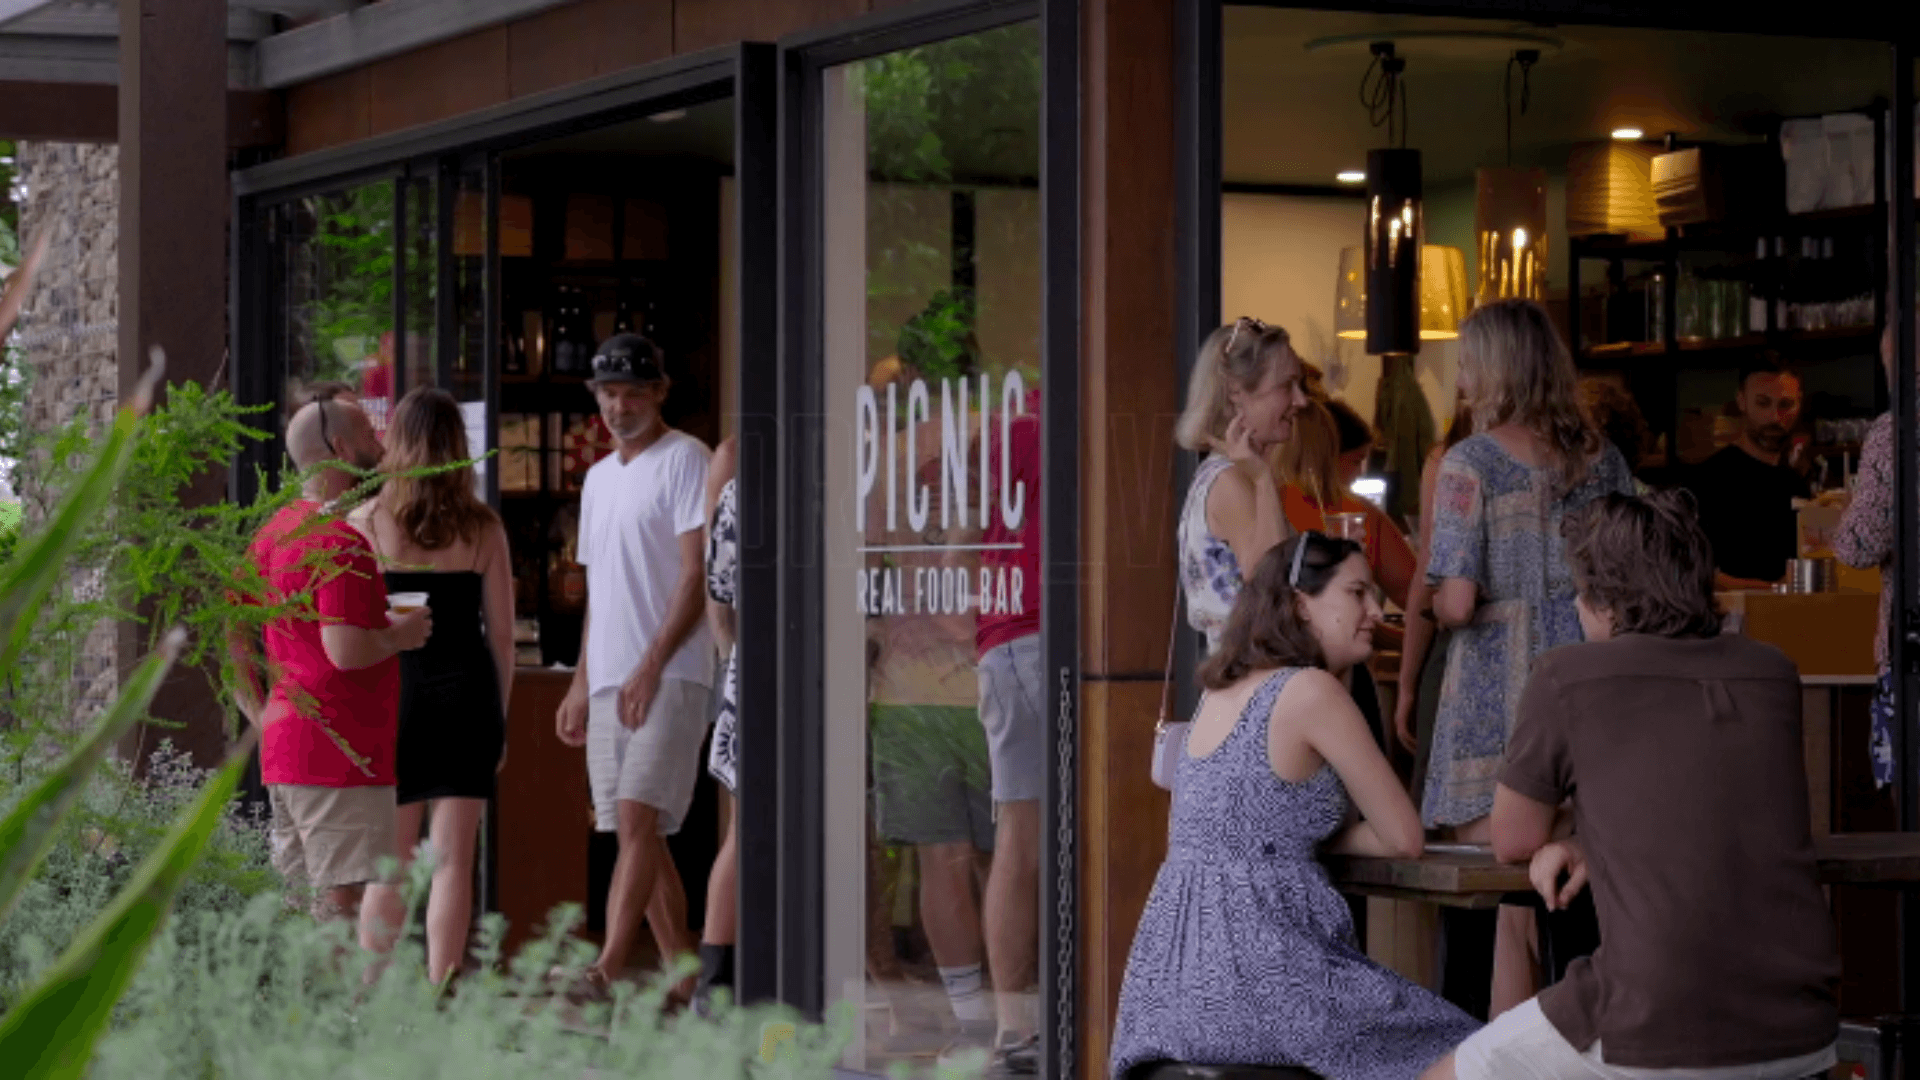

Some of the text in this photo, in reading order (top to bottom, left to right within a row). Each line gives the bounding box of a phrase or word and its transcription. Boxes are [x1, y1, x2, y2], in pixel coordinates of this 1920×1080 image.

[856, 369, 1025, 532] PICNIC
[856, 567, 1023, 614] REAL FOOD BAR
